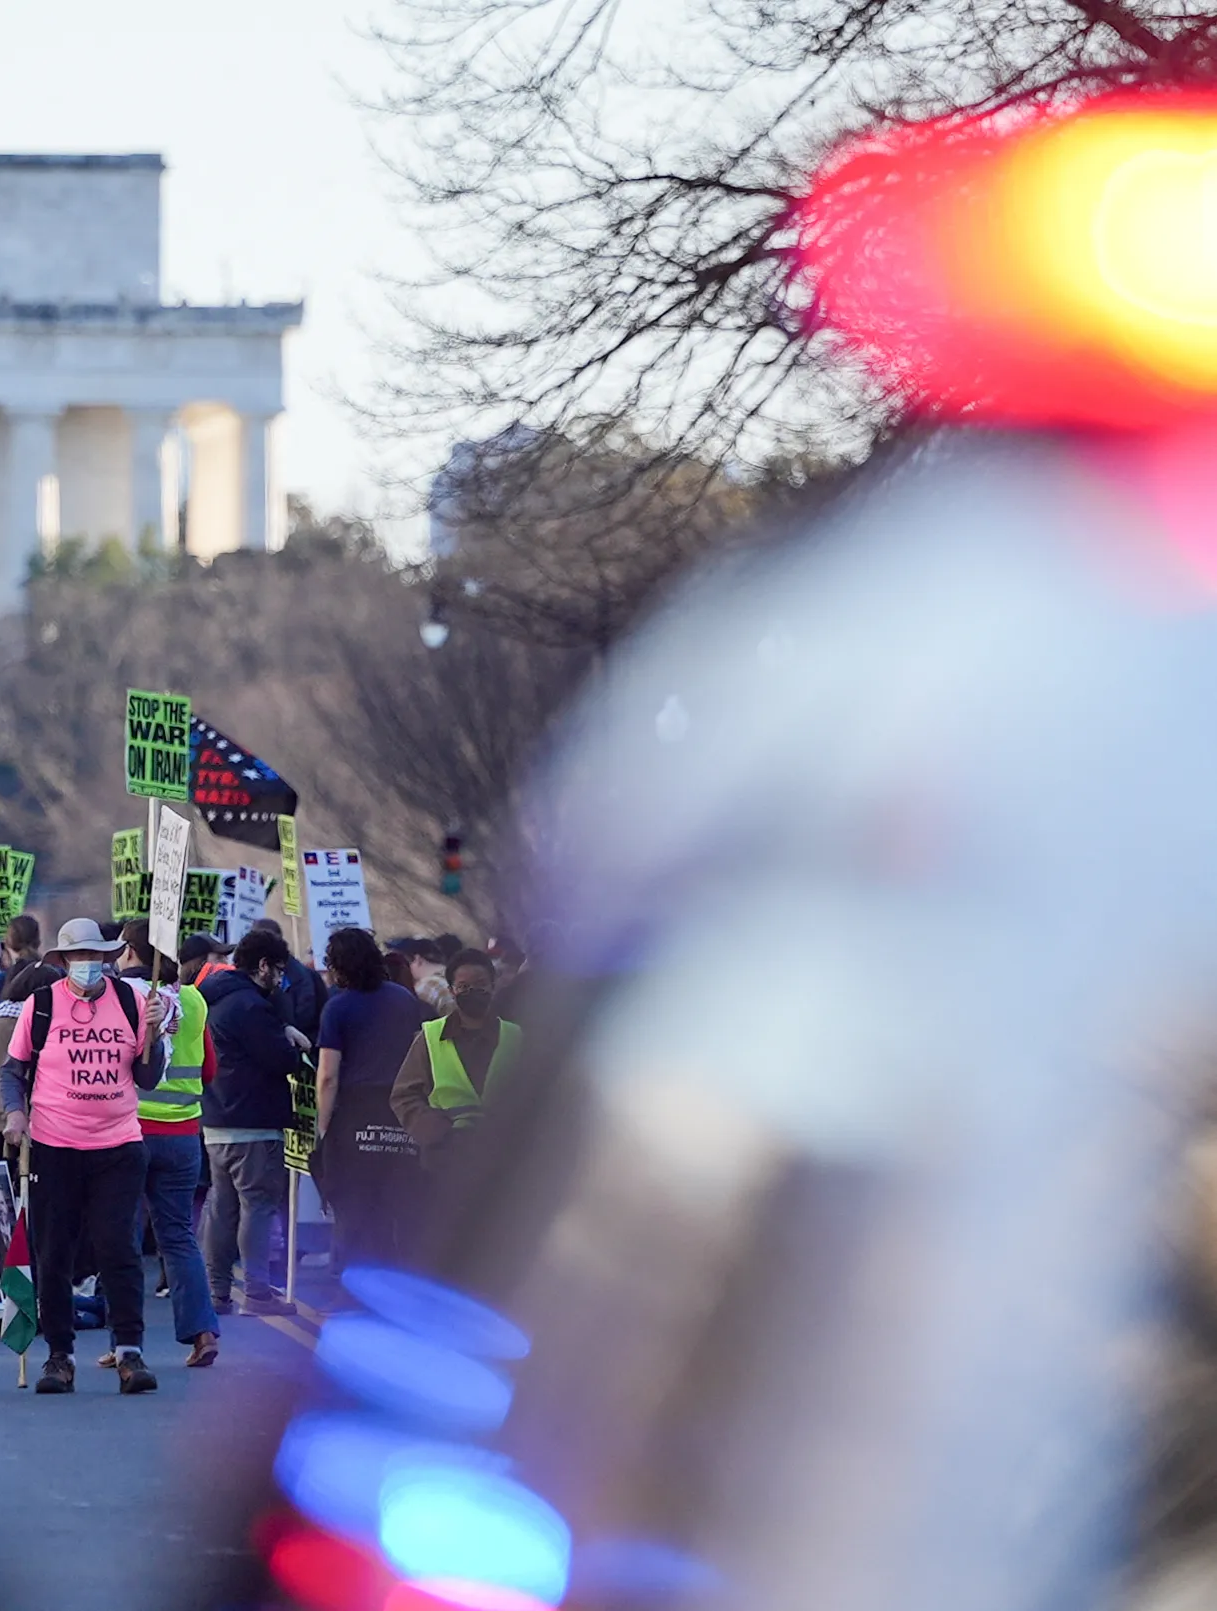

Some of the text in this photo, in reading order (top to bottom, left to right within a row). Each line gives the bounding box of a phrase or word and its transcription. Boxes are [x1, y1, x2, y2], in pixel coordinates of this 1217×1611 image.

[129, 696, 187, 724] STOP THE
[129, 719, 186, 746] WAR
[129, 745, 146, 780] ON
[187, 873, 219, 897] EW
[185, 897, 215, 915] AR
[59, 1028, 125, 1044] PEACE
[68, 1049, 121, 1064] WITH
[71, 1070, 119, 1085] IRAN
[355, 1131, 415, 1144] FUJI MOUNTA
